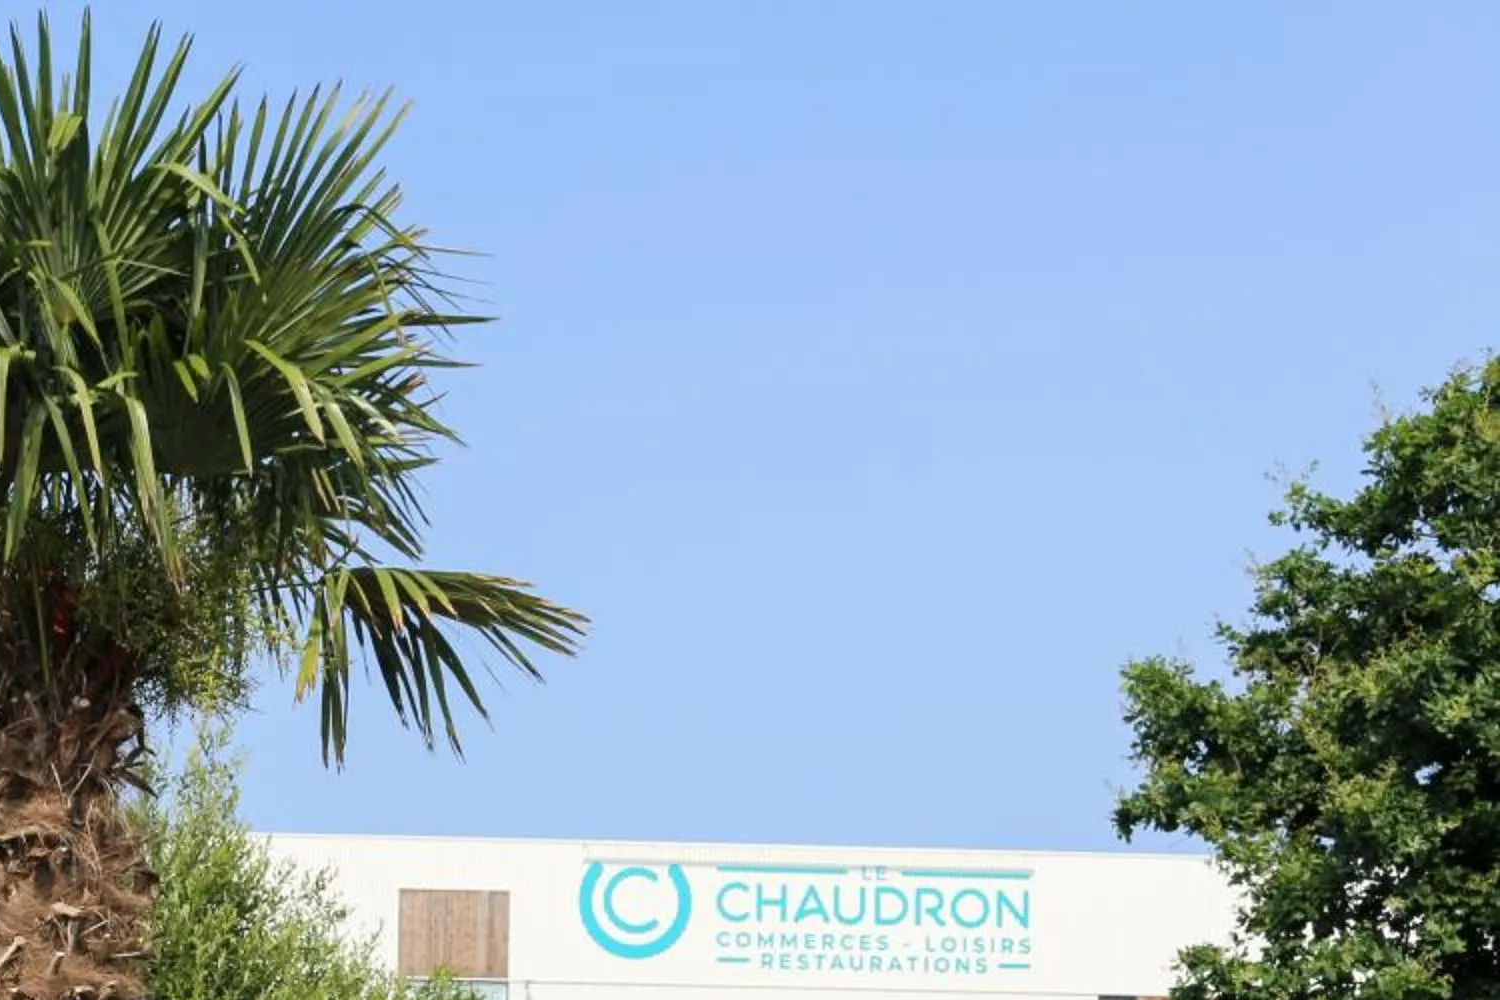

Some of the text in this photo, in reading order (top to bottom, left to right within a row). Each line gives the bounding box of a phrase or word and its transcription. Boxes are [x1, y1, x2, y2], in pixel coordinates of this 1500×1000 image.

[861, 865, 888, 880] LE
[716, 881, 1030, 929] CHAUDRON
[716, 931, 889, 952] COMMERCES
[925, 936, 1031, 954] LOISIRS
[761, 953, 987, 974] RESTAURATIONS
